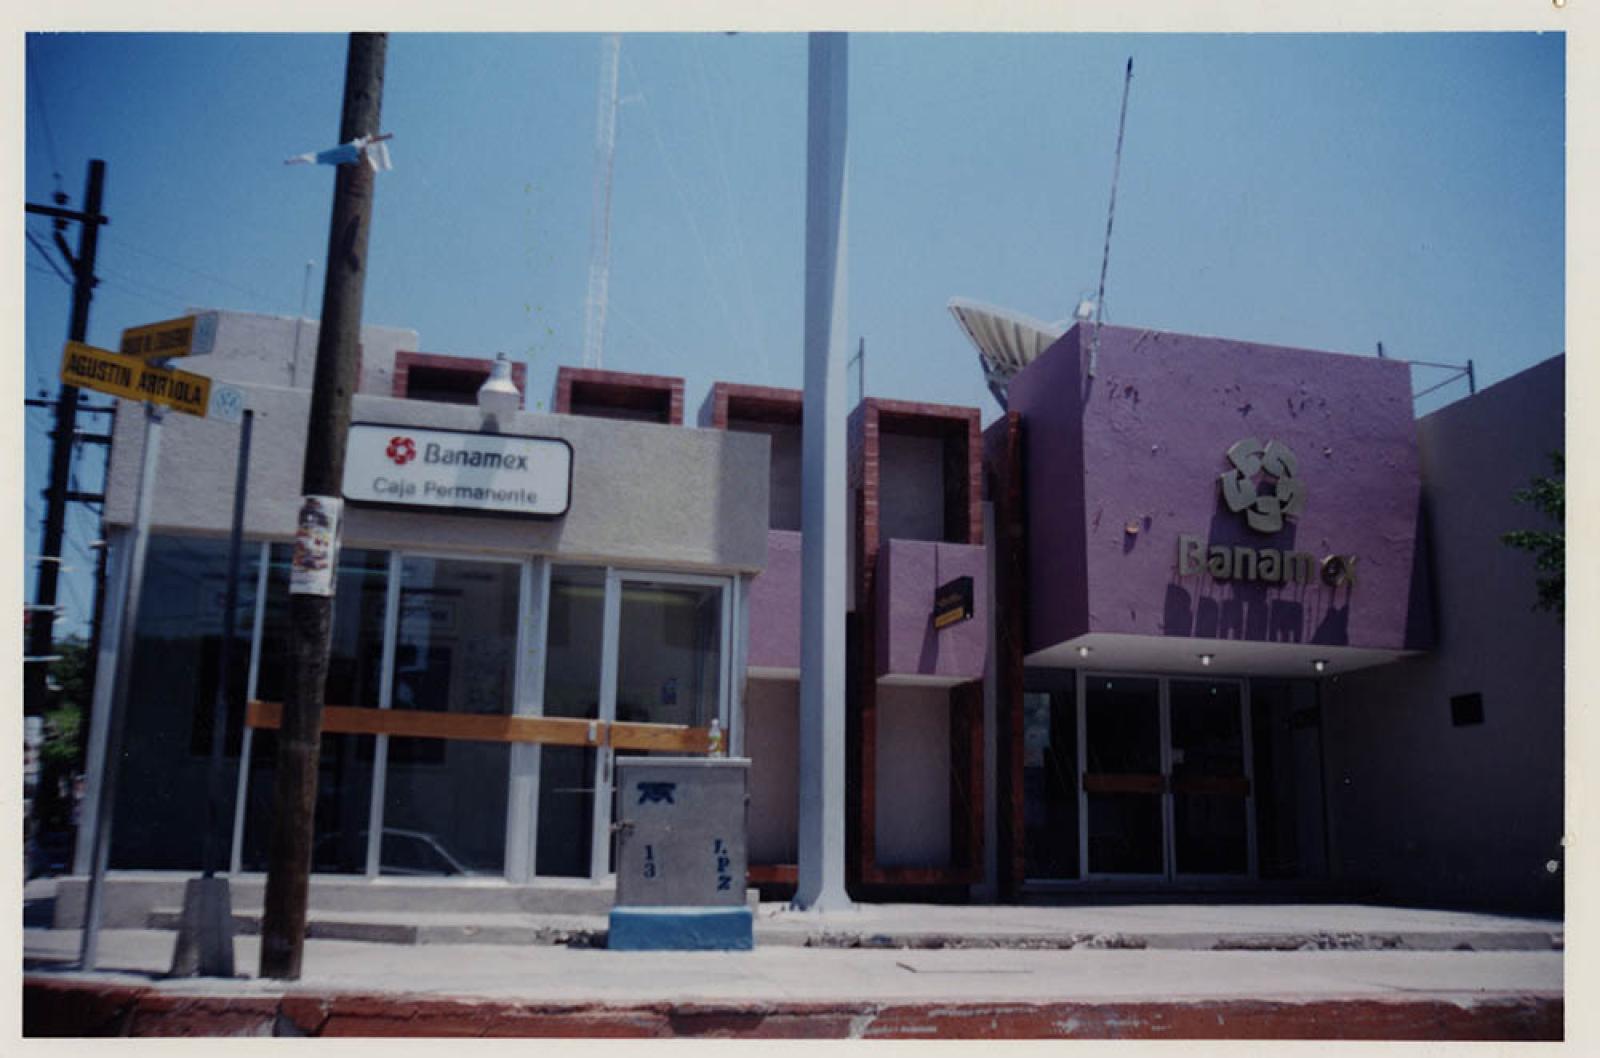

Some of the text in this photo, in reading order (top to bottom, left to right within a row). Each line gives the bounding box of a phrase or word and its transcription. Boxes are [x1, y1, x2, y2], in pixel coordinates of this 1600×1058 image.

[66, 352, 133, 388] AGUSTIN
[424, 442, 528, 470] Banamex
[373, 477, 537, 504] Caja Permanente
